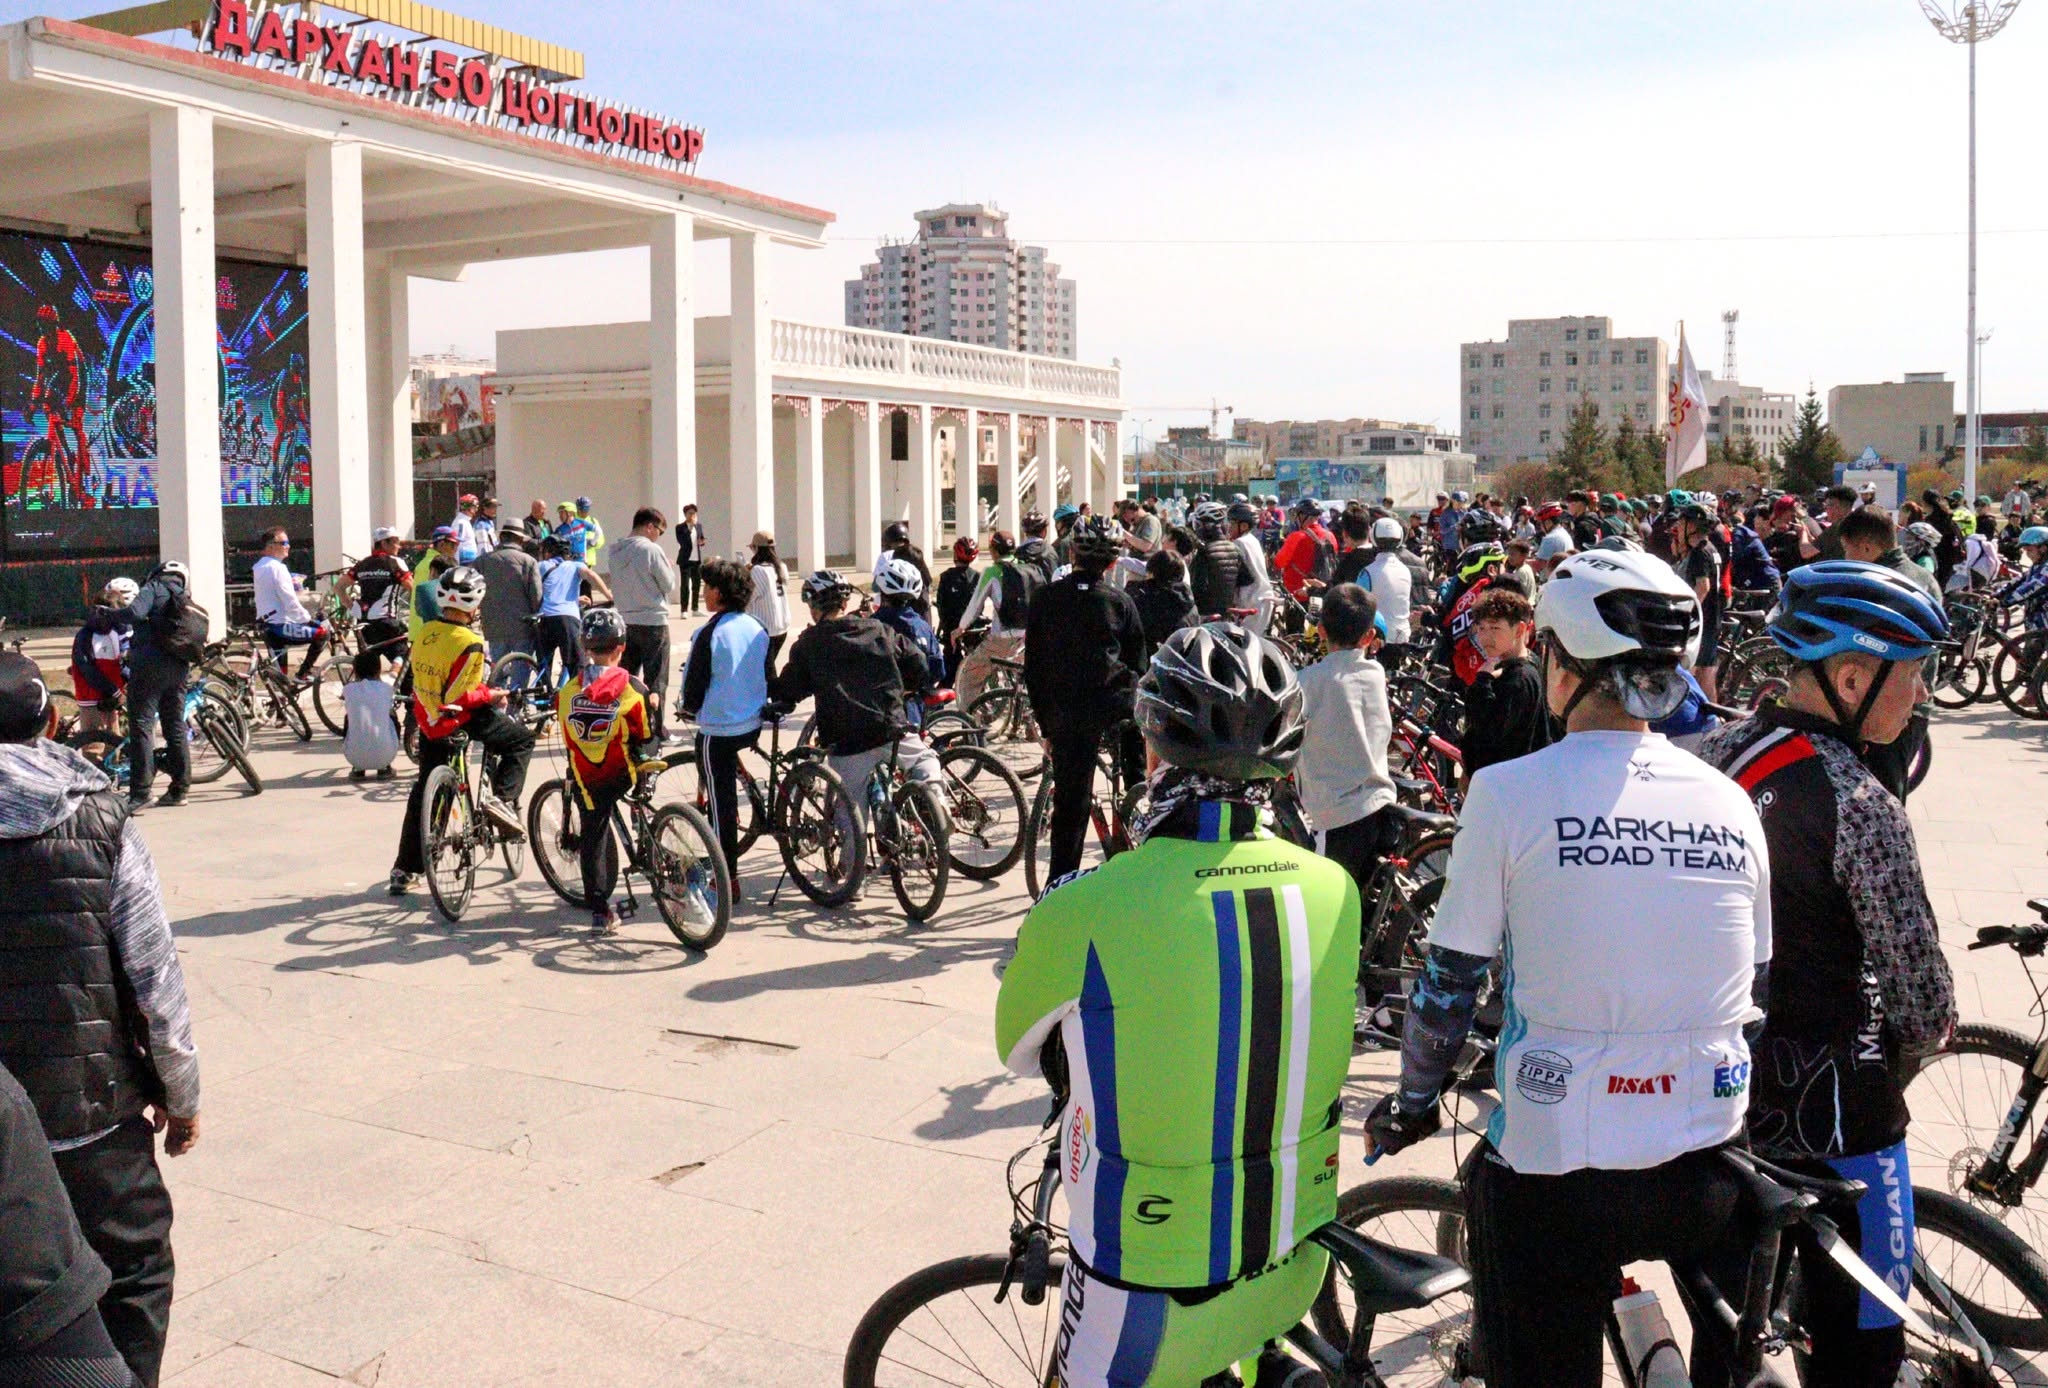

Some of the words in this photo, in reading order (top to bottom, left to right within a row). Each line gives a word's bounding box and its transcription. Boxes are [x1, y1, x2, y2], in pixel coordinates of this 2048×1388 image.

[213, 0, 419, 91] ДАРХАН
[431, 50, 492, 107] 50
[502, 78, 704, 163] ЦОГЦОЛБОР
[1554, 816, 1745, 849] DARKHAN
[1195, 861, 1299, 878] cannondale
[1559, 845, 1654, 867] ROAD
[1660, 847, 1746, 873] TEAM
[1518, 1063, 1566, 1084] ZIPPA
[1070, 1101, 1084, 1184] sojasun
[1314, 1168, 1337, 1185] SU
[1877, 1150, 1906, 1259] GIAN
